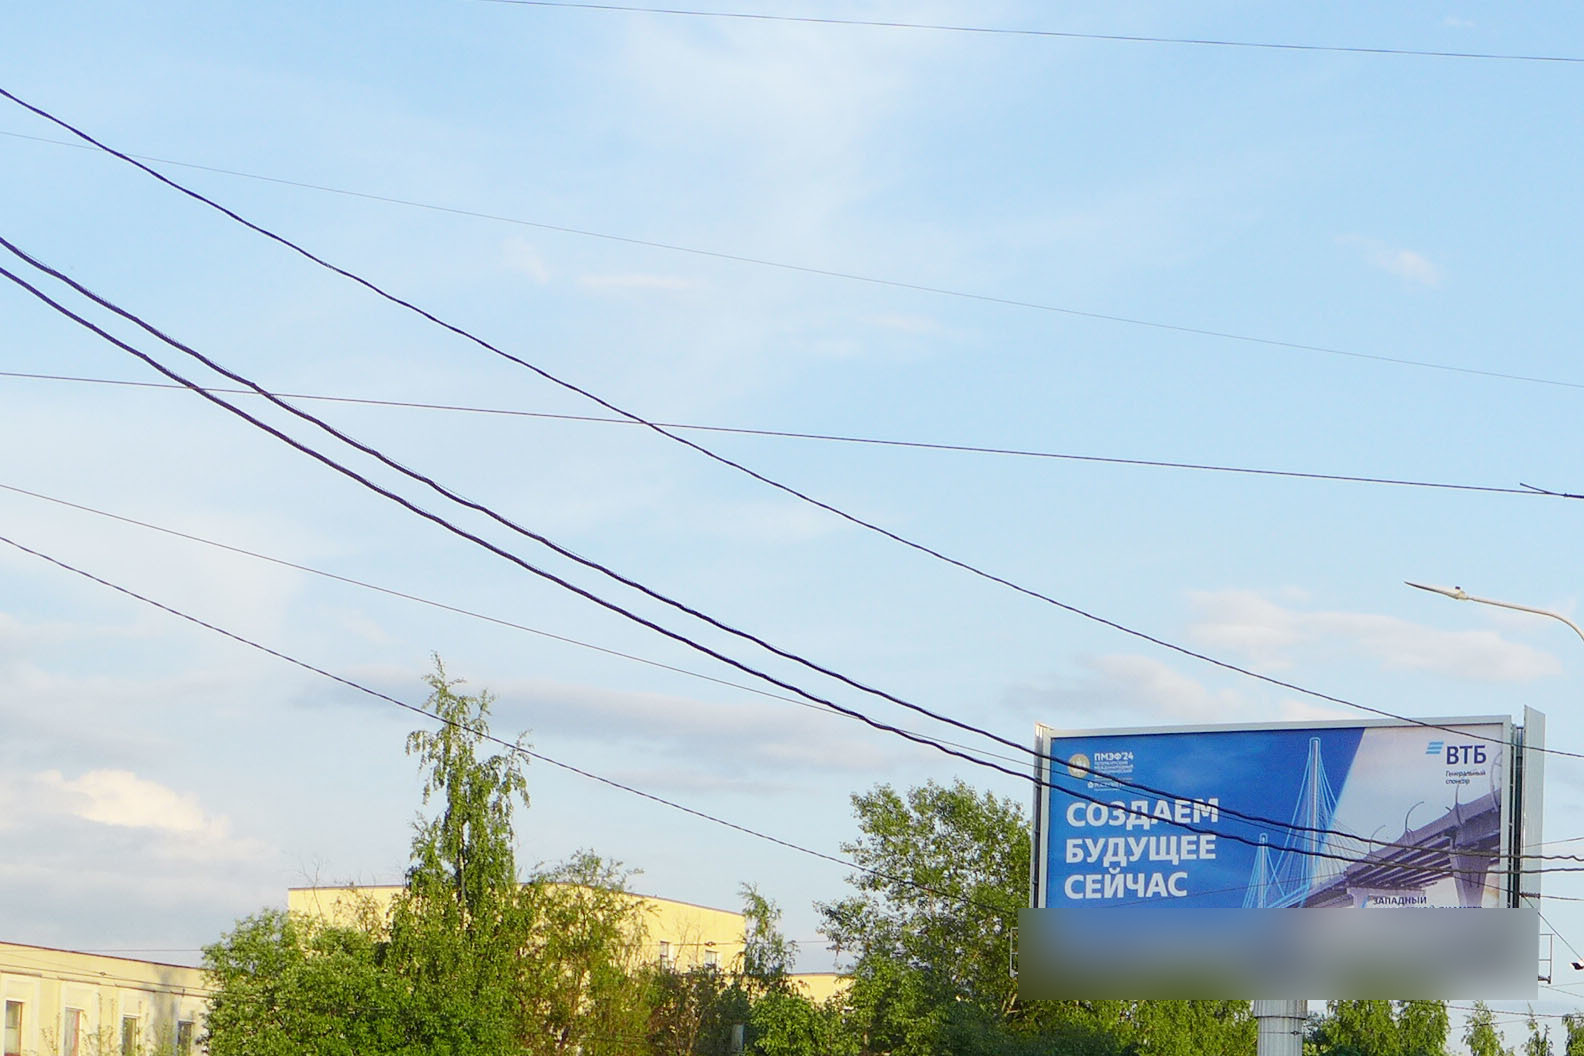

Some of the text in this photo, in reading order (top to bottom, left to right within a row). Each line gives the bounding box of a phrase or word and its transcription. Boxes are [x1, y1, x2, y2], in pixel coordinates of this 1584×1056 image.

[1446, 745, 1487, 765] ВТБ
[1066, 798, 1219, 830] СОЗДАЕМ
[1066, 835, 1217, 867] БУДУЩЕЕ
[1064, 867, 1188, 899] СЕЙЧАС
